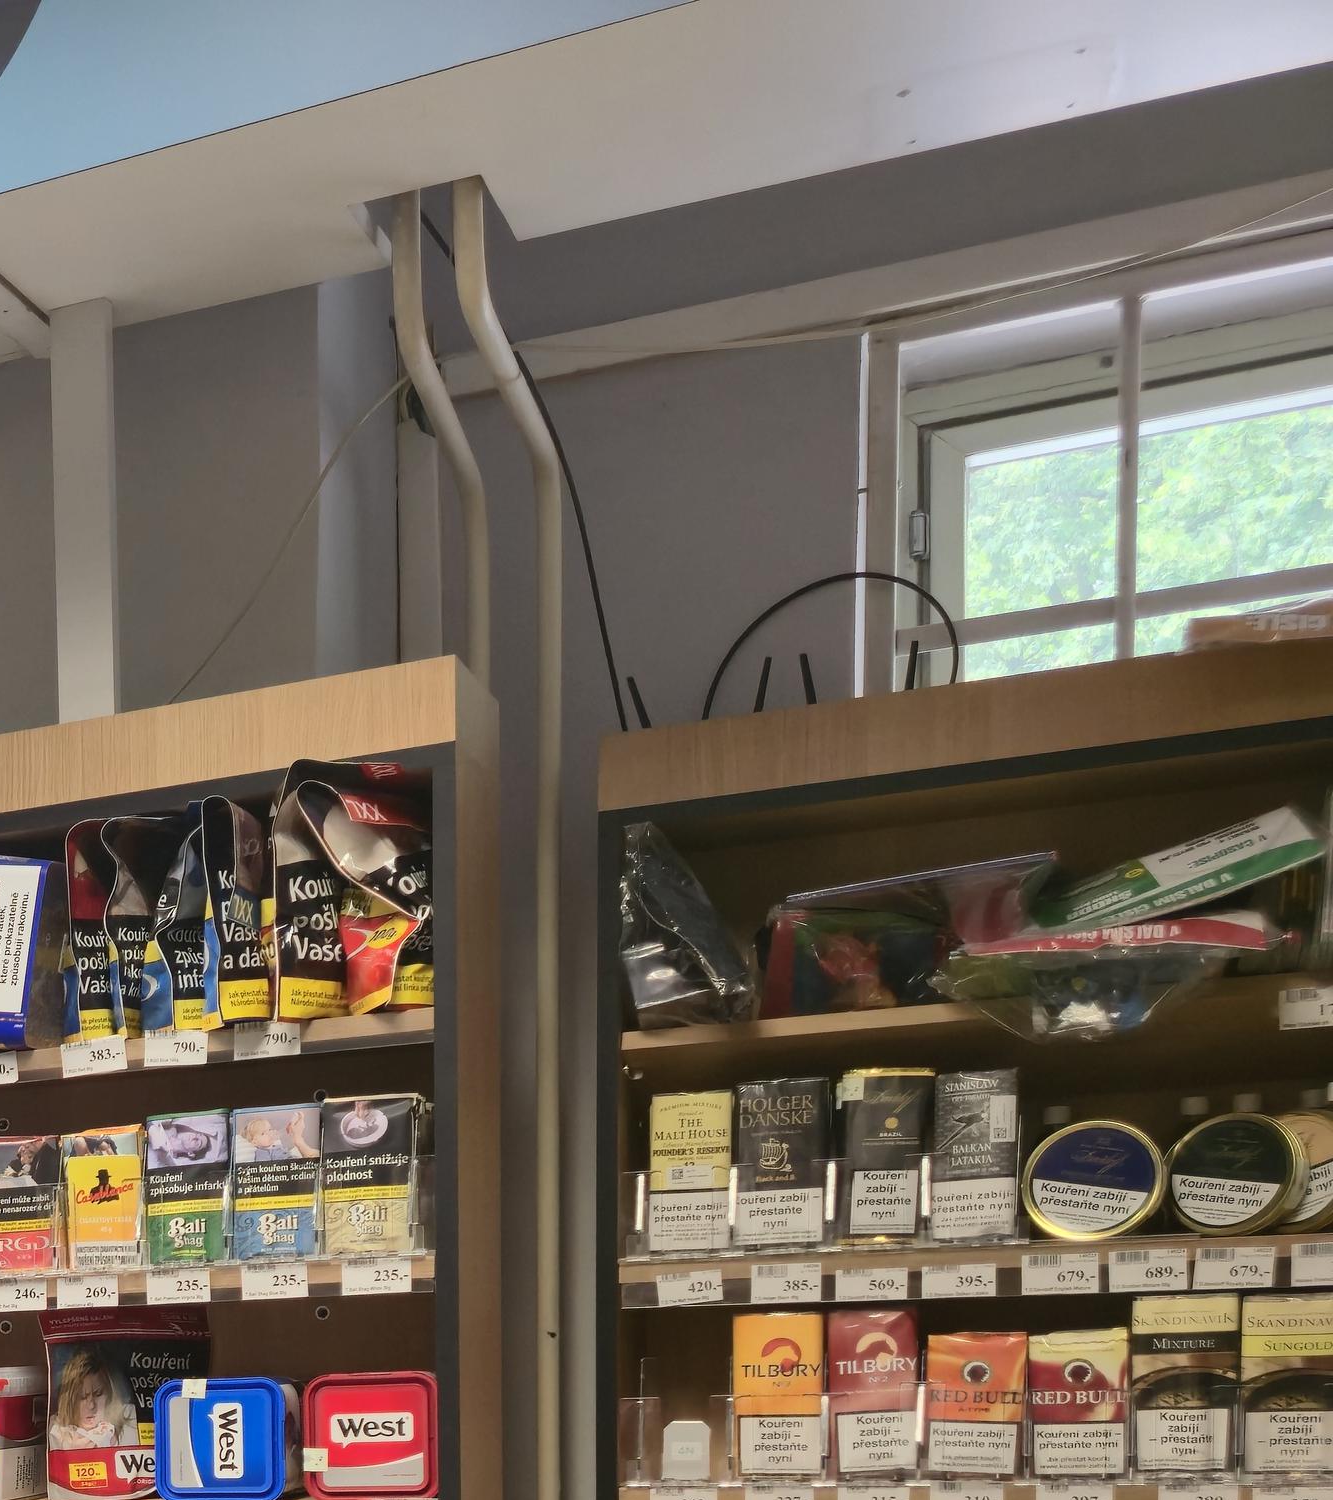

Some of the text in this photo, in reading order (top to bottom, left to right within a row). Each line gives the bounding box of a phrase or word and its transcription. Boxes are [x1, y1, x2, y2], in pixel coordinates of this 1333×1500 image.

[173, 1039, 206, 1055] 790,-
[945, 1079, 999, 1094] STANISLAW
[739, 1095, 813, 1113] HOLGER
[739, 1111, 813, 1129] DANSKE
[373, 1268, 409, 1284] 235,-
[1057, 1270, 1096, 1284] 679,-
[783, 1279, 822, 1293] 385,-
[1152, 1337, 1215, 1350] MIXTURE
[836, 1358, 917, 1375] TILBURY
[1031, 1390, 1070, 1405] RED
[337, 1416, 406, 1439] West
[215, 1404, 238, 1476] West
